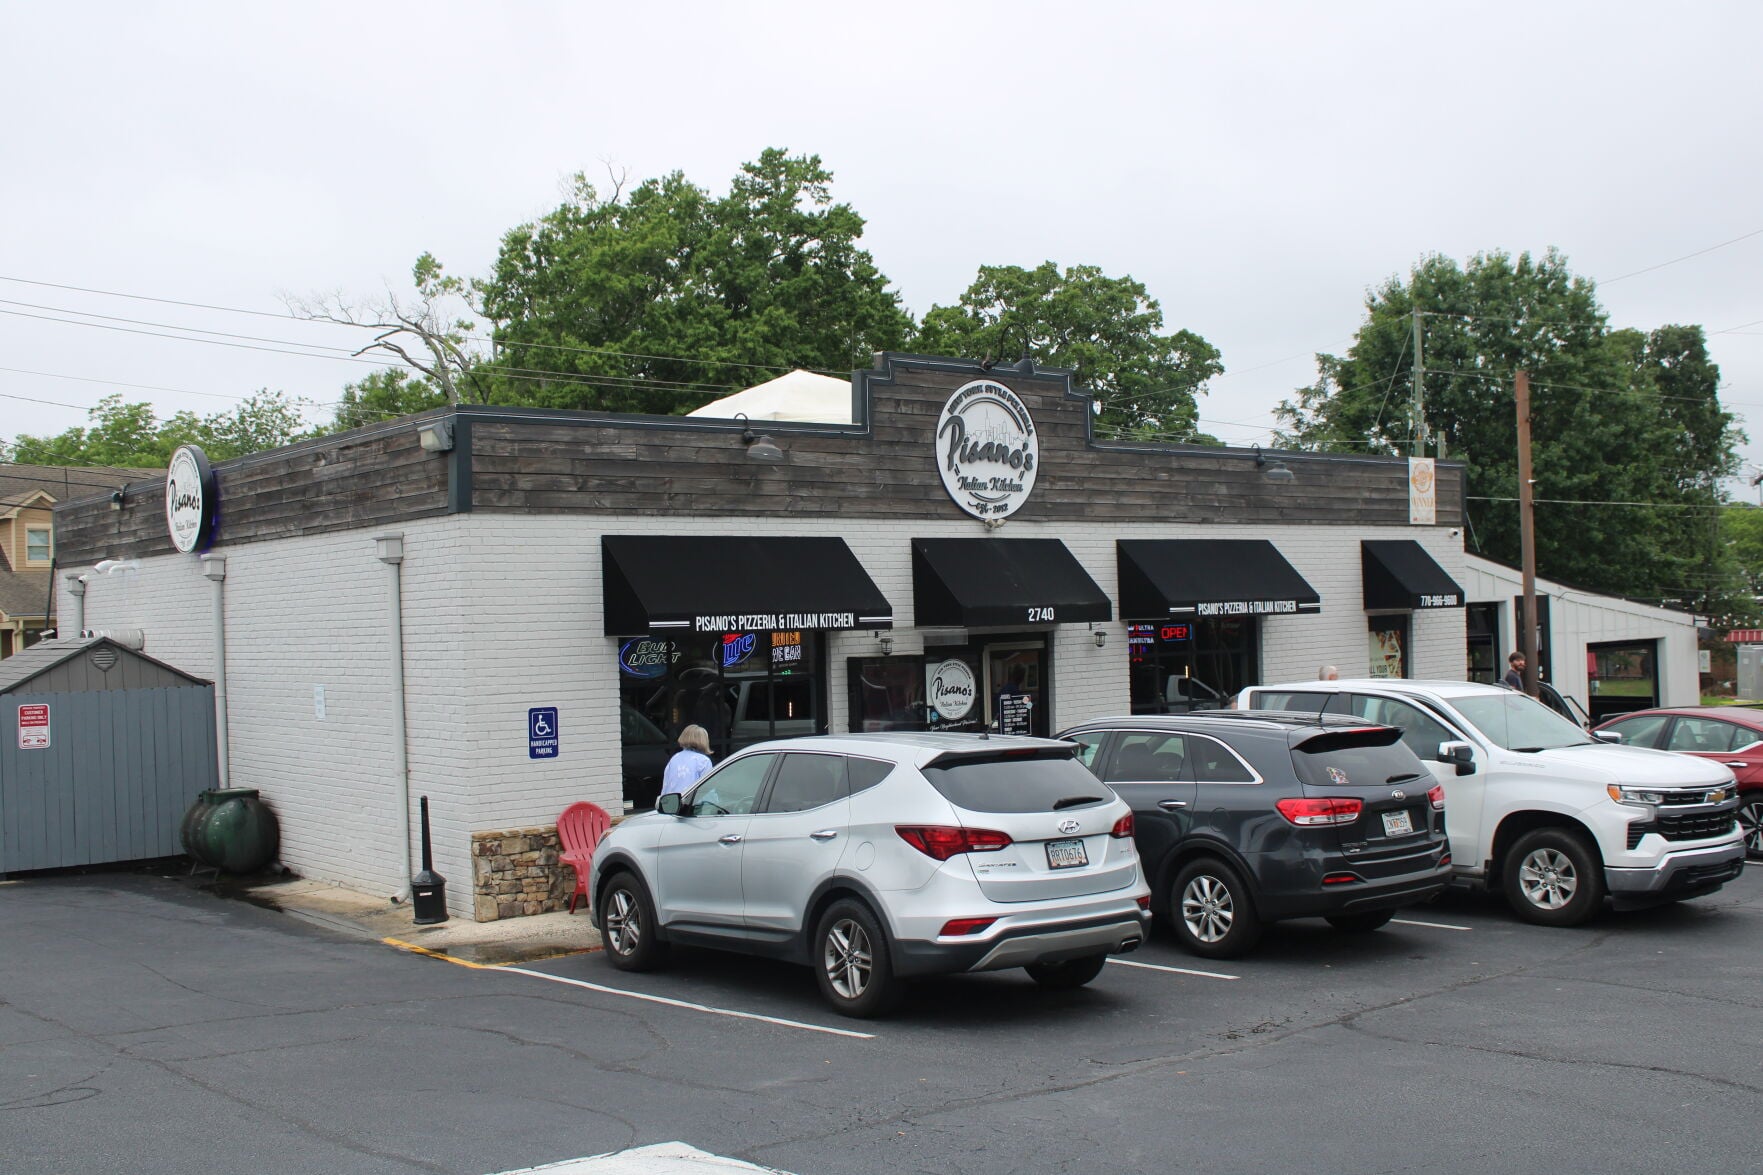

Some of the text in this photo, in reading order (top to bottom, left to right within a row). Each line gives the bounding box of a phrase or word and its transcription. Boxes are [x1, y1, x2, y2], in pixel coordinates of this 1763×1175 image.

[948, 393, 964, 415] NEW
[962, 384, 984, 398] YORK
[984, 384, 1007, 400] STYLE
[938, 415, 1034, 472] Pisano's
[957, 476, 1023, 492] Italian Kitchen
[167, 479, 200, 519] Pisano's
[1028, 607, 1055, 621] 2740
[1198, 601, 1296, 615] PISANO'S PIZZERIA & ITALIAN KITCHEN
[696, 613, 854, 631] PISANO'S PIZZERIA & ITALIAN KITCHEN
[932, 676, 972, 700] Pisano's
[530, 739, 558, 747] HANDICAPPED
[535, 747, 553, 755] PARKING
